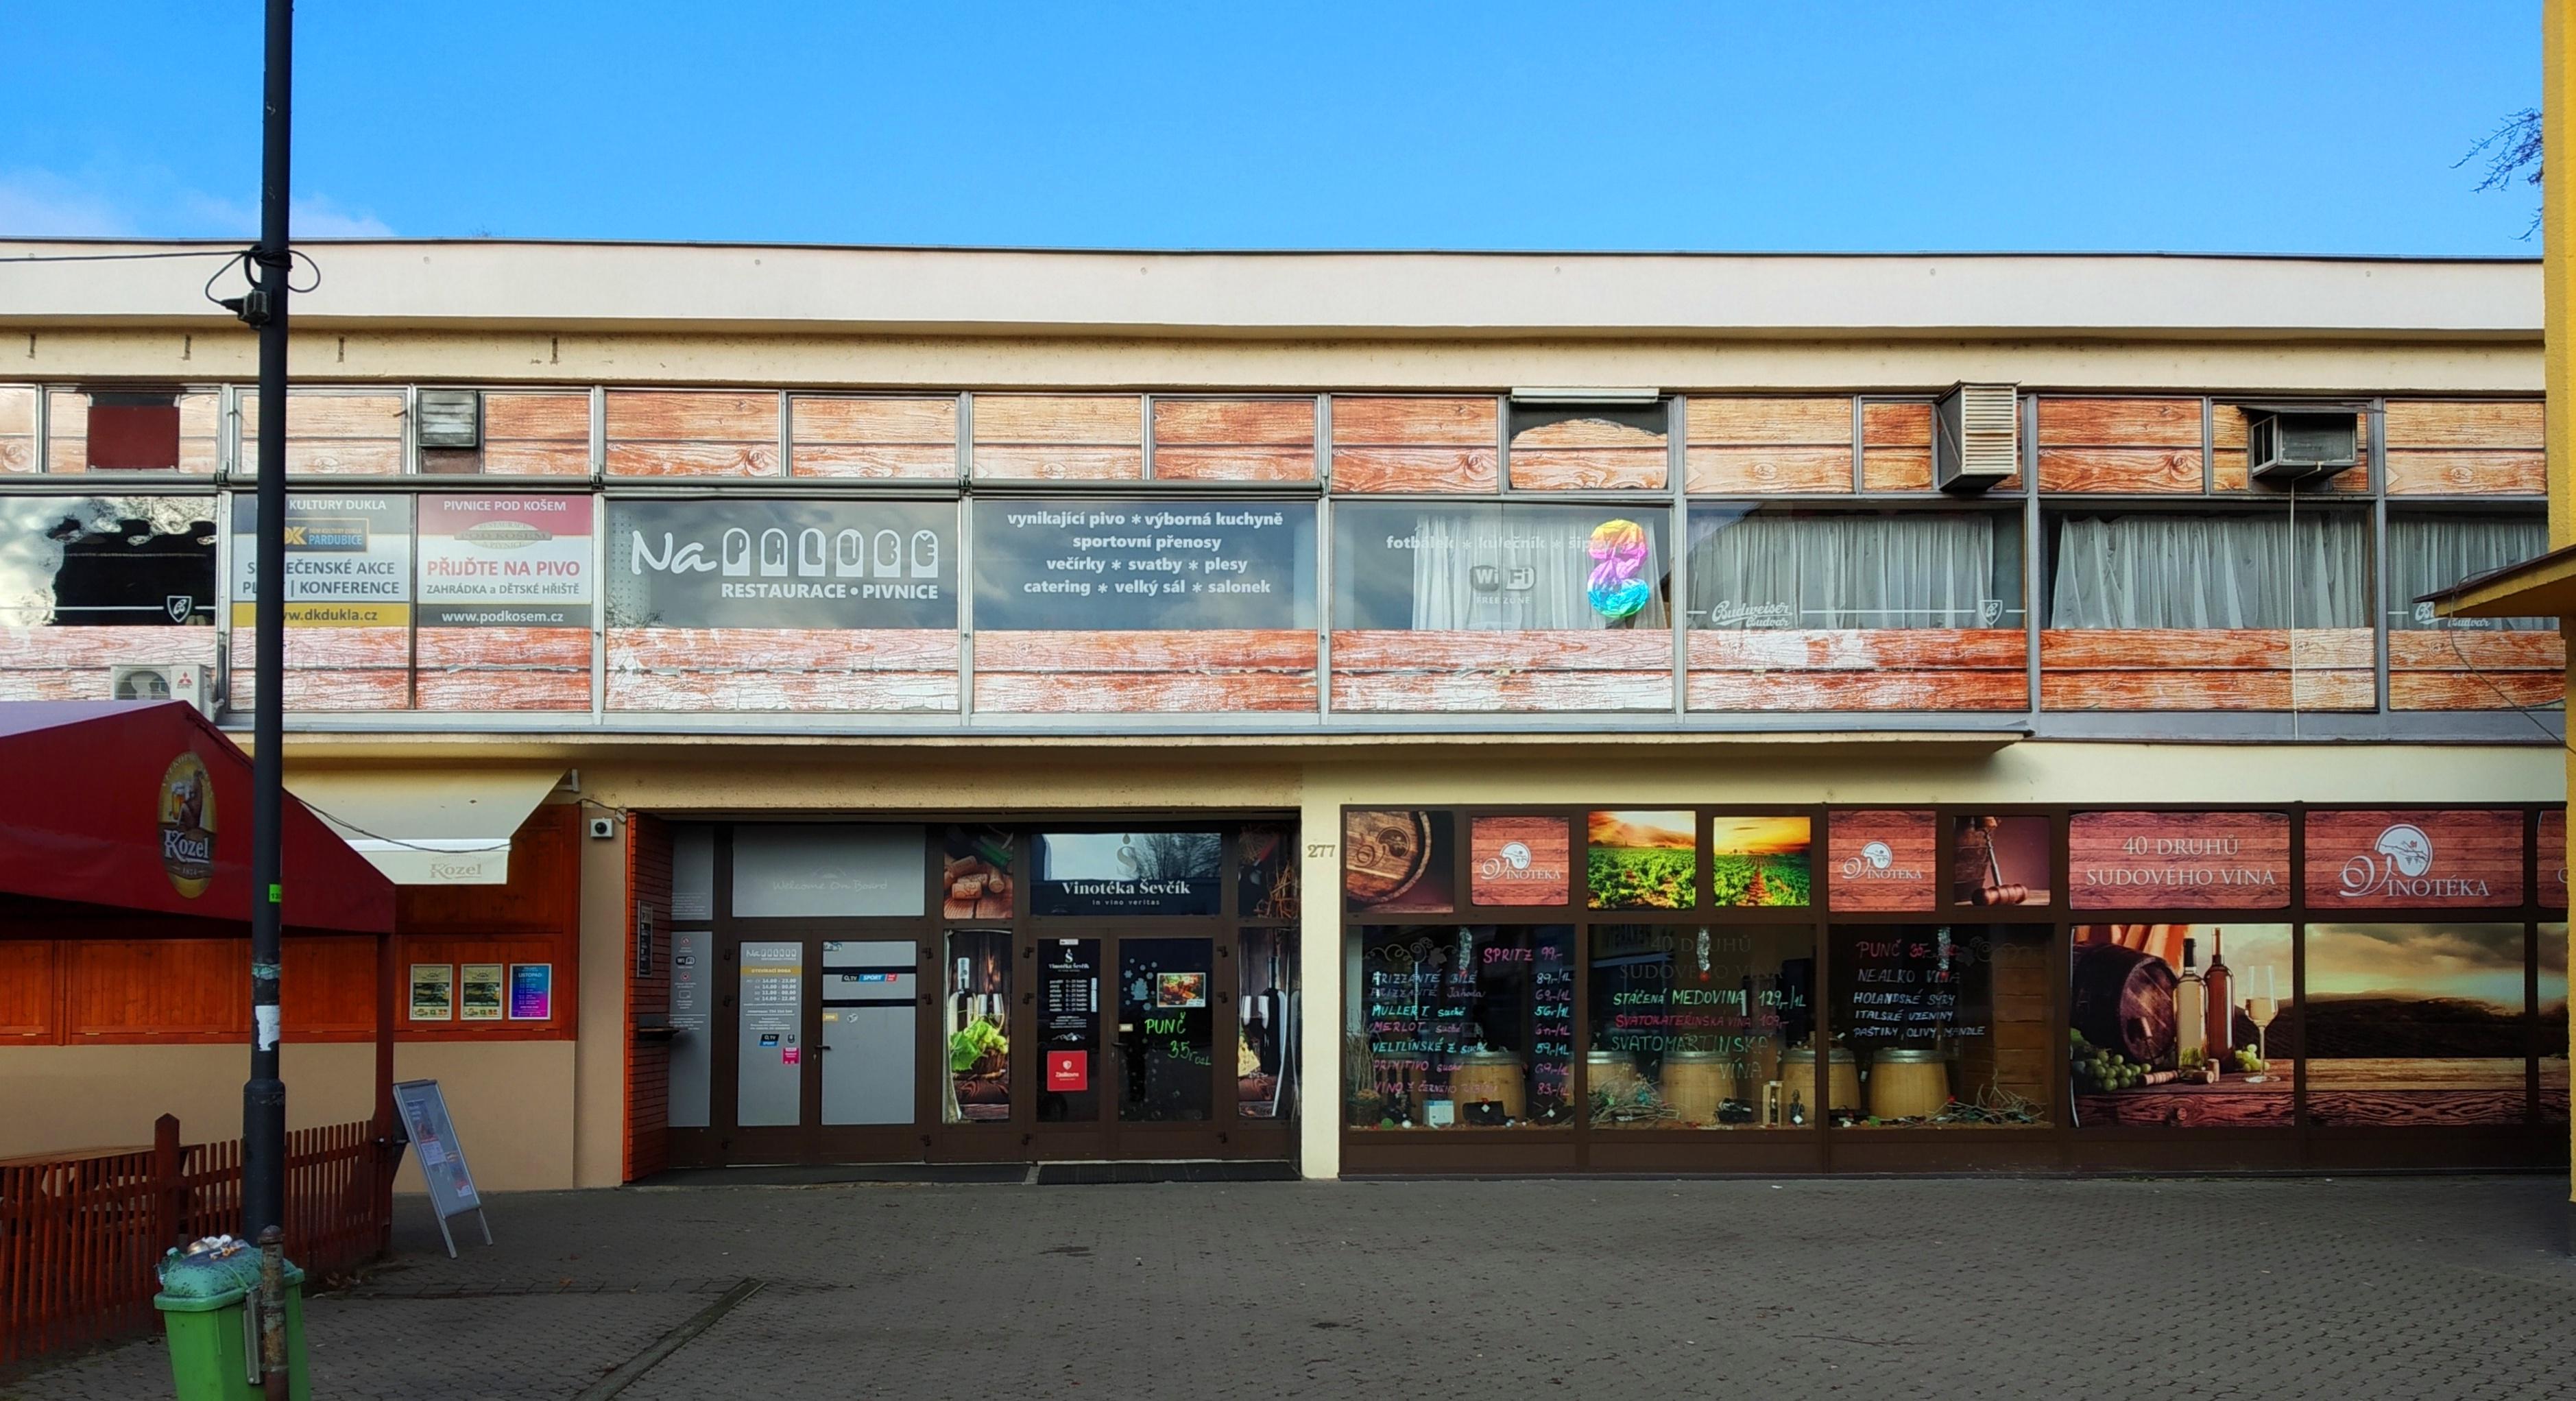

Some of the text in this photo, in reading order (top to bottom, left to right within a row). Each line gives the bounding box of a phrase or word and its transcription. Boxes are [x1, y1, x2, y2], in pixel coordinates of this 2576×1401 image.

[289, 499, 387, 510] KULTURY DUKLA
[444, 499, 566, 511] PIVNICE POD KOŠEM
[1007, 512, 1284, 529] vynikající pivo výborná kuchyně
[309, 534, 362, 545] PARDUBICE
[1072, 534, 1221, 551] sportovní přenosy
[1386, 536, 1454, 549] fotbálek
[631, 530, 717, 575] Na
[248, 559, 395, 575] SEČENSKÉ AKCE
[426, 556, 580, 576] PŘIJĎTE NA PIVO
[1046, 557, 1248, 574] večírky svatby plesy
[300, 582, 400, 595] KONFERENCE
[426, 582, 579, 595] ZAHRÁDKA a DĚTSKÉ HŘIŠTĚ
[721, 583, 939, 600] RESTAURACE PIVNICE
[1024, 579, 1271, 597] catering velký sál salonek
[442, 610, 564, 624] www.podkosem.cz
[1711, 600, 1792, 623] Budweiser
[1746, 614, 1792, 627] Budvar
[164, 828, 210, 864] Kozel
[1307, 844, 1336, 858] 277
[2121, 835, 2239, 856] 40 DRUHŮ
[430, 863, 482, 880] Kozel
[2086, 865, 2276, 886] SUDOVÉHO VÍNA
[2338, 854, 2491, 897] VINOTÉKA
[773, 880, 825, 890] Welcome
[1062, 878, 1191, 894] Vinotéka Ševčík
[1681, 934, 1751, 953] DUHŮ
[1855, 938, 1902, 959] PUNČ
[1483, 947, 1534, 964] SPRITZ
[1619, 963, 1729, 980] SUDOVÉO
[1857, 968, 1915, 983] NEALKO
[1613, 987, 1668, 1005] STÁČENÁ
[1672, 989, 1747, 1005] MEDOVINA
[1853, 989, 1924, 1005] HOLANDSKÉ
[1144, 1011, 1187, 1034] PUNČ
[1855, 1009, 1904, 1022] ITALSKÉ
[1373, 1022, 1427, 1033] MERLOT
[1372, 1037, 1445, 1053] VELTLÍNSKÉ
